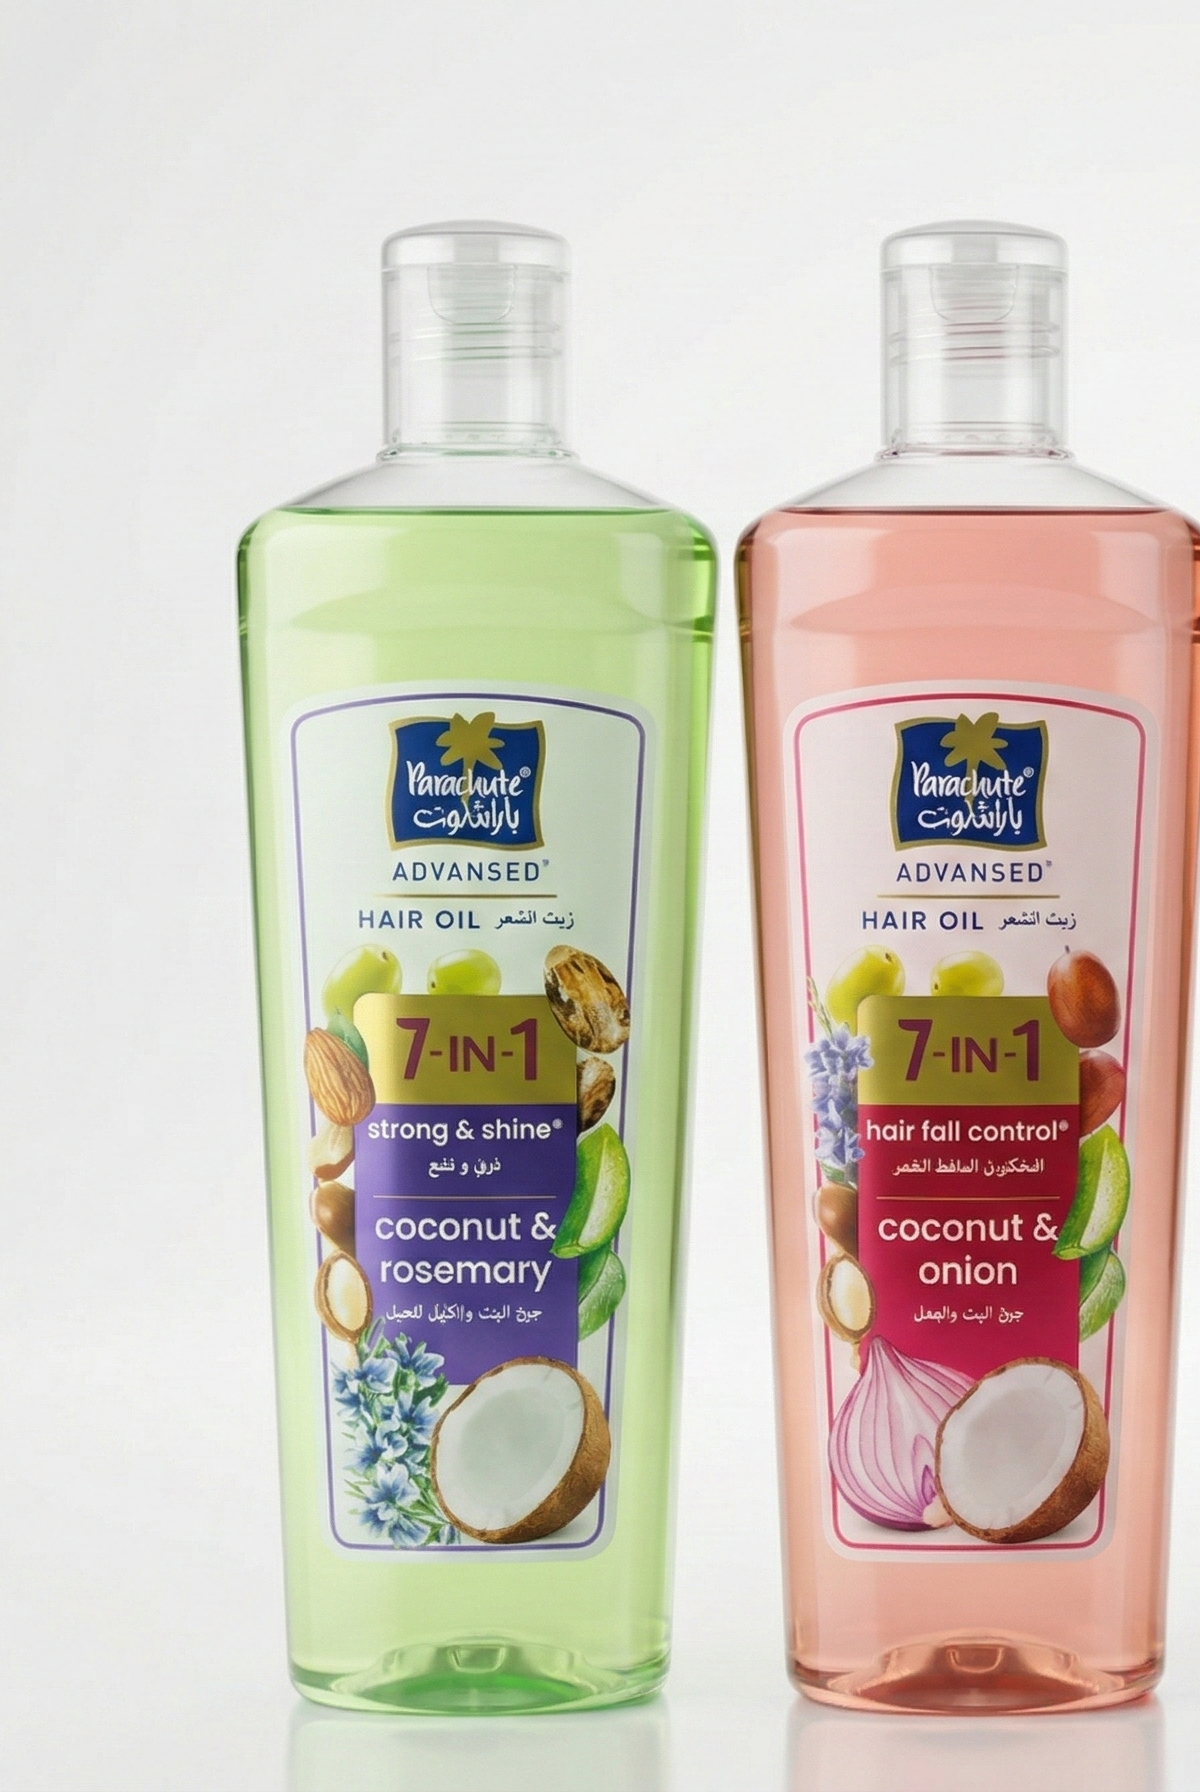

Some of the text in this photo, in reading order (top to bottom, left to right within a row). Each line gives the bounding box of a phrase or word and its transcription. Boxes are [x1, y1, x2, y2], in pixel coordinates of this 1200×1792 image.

[359, 910, 480, 928] HAIR OIL
[543, 913, 574, 928] زيت
[863, 912, 983, 930] HAIR OIL
[1045, 914, 1076, 930] زيت
[396, 1018, 537, 1080] 7-IN-1
[898, 1019, 1039, 1081] 7-IN-1
[368, 1120, 448, 1146] strong
[456, 1119, 475, 1140] &
[866, 1120, 914, 1141] hair
[922, 1119, 961, 1141] fall
[375, 1212, 557, 1240] coconut &
[878, 1213, 1058, 1241] coconut &
[380, 1258, 552, 1292] rosemary
[919, 1255, 1017, 1284] onion
